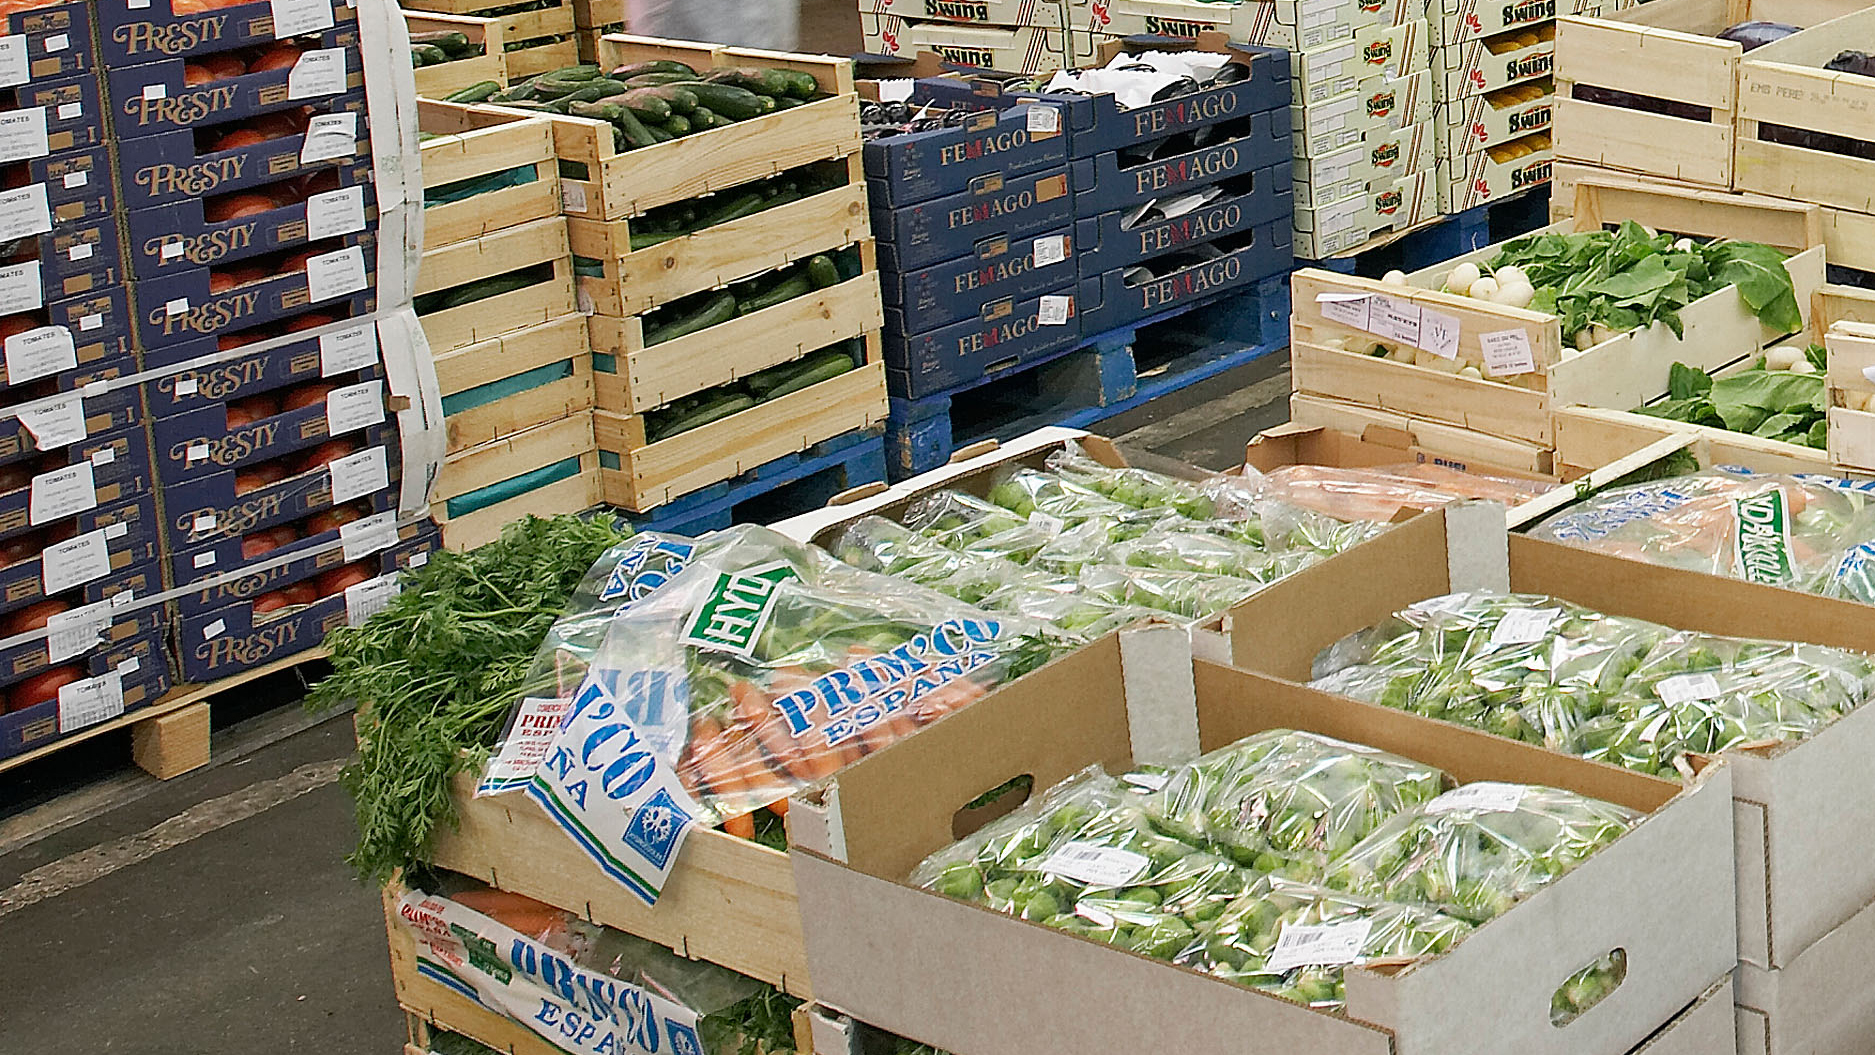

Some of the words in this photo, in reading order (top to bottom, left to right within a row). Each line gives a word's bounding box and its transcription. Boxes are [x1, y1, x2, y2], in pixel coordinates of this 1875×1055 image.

[113, 15, 228, 54] PRESTY
[1507, 52, 1554, 83] Swin
[1134, 90, 1237, 137] FEMAGO
[1509, 107, 1551, 135] Swin
[940, 128, 1027, 166] FEMAGO
[135, 153, 248, 196] PRESTY
[1135, 146, 1239, 195] FEMAGO
[1512, 161, 1551, 191] Swin
[948, 190, 1033, 230] FEMAGO
[1140, 204, 1241, 255] FEMAGO
[954, 253, 1034, 294] FEMAGO
[1142, 256, 1240, 310] FEMAGO
[958, 314, 1039, 357] FEMAGO
[773, 619, 1002, 739] PRIM'CO
